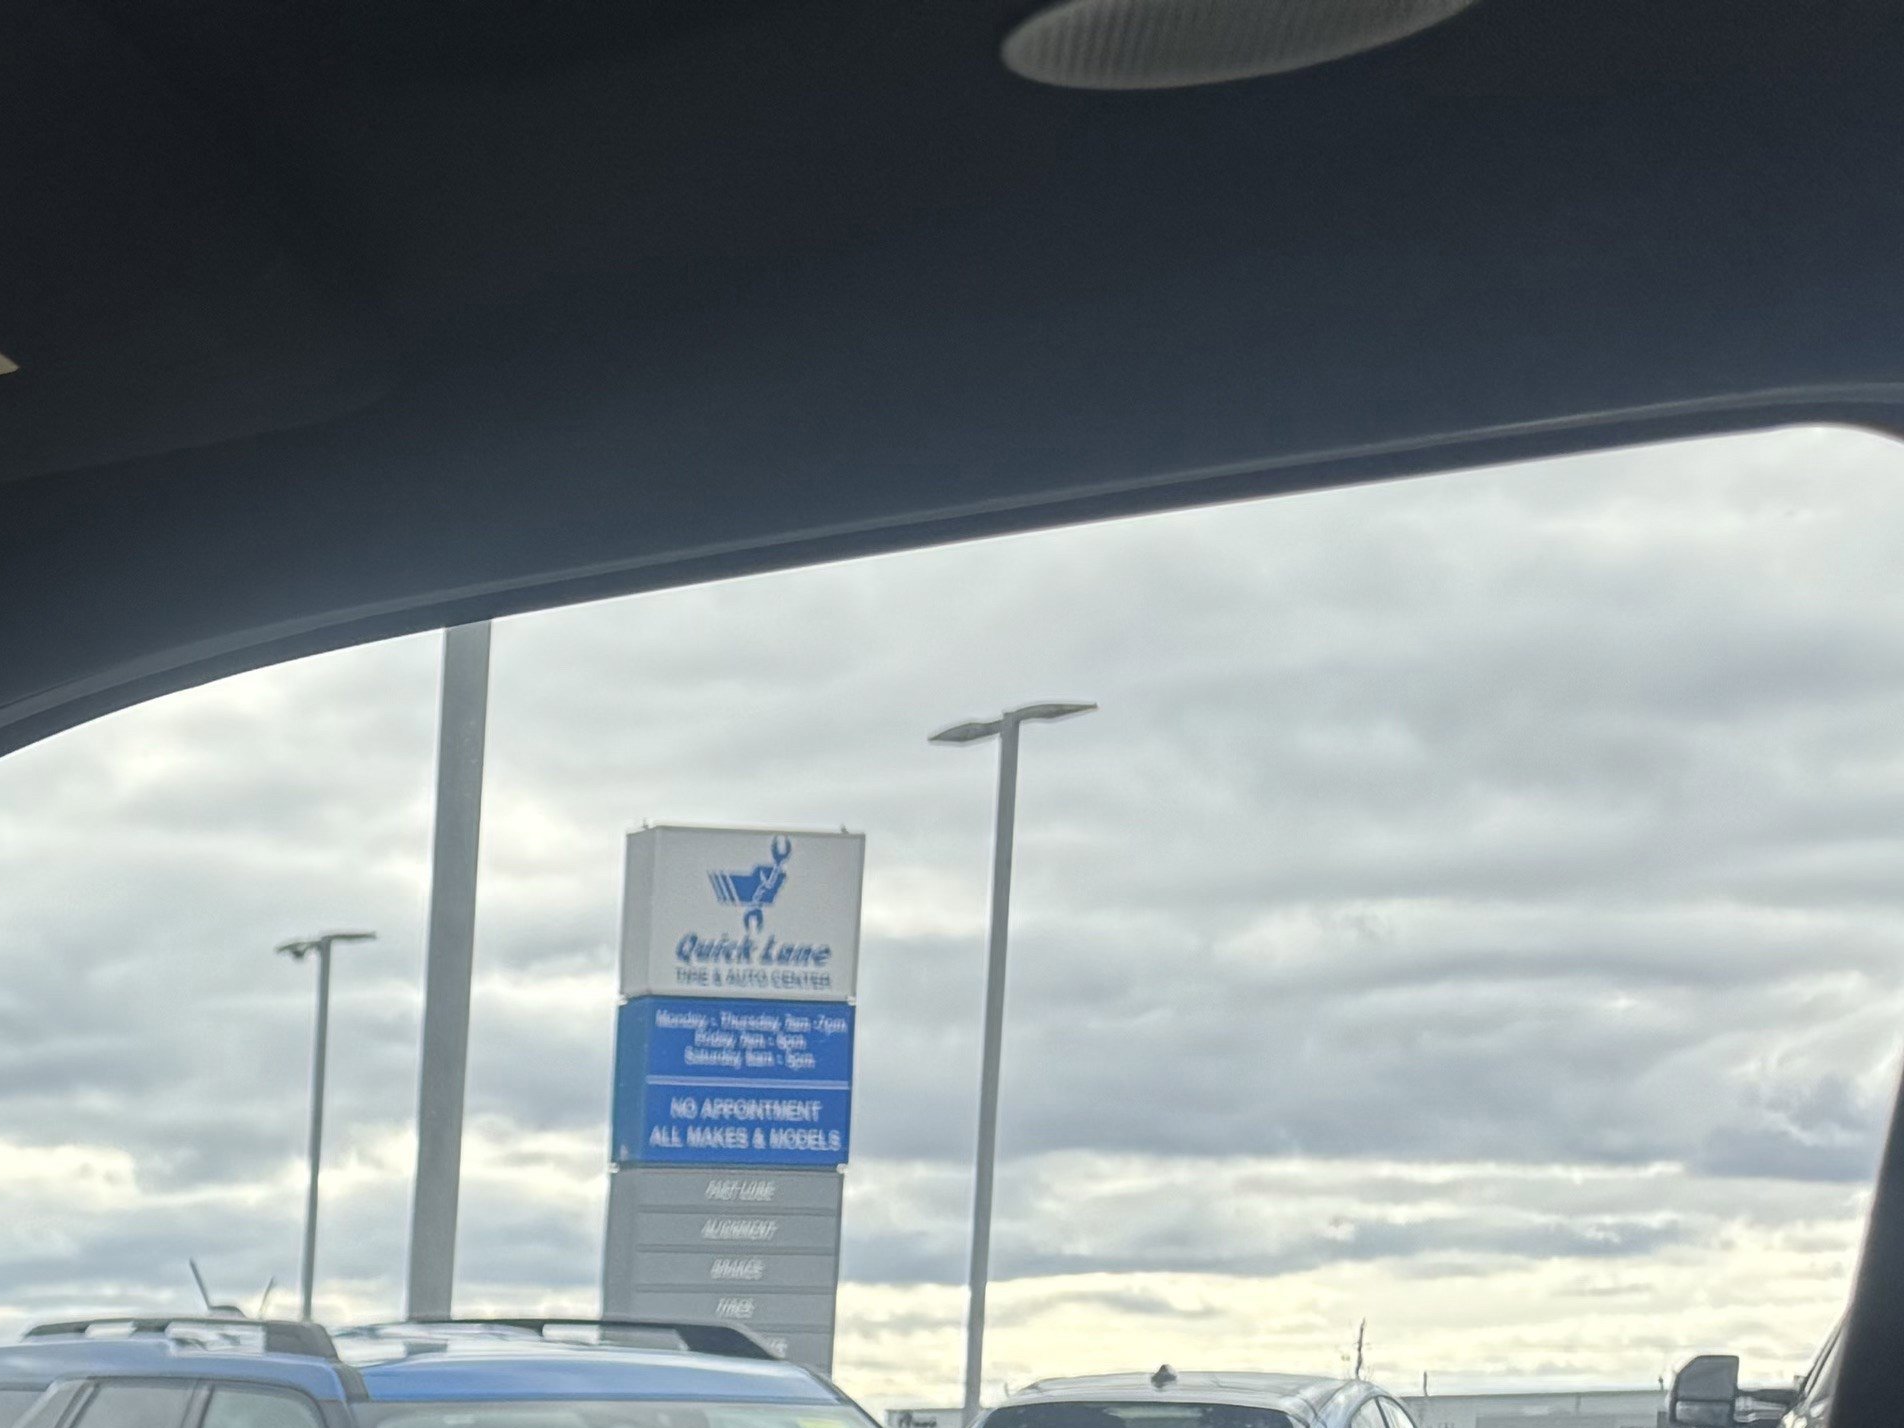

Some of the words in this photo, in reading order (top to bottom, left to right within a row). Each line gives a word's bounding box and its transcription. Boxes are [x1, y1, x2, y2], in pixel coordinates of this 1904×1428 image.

[675, 932, 755, 965] Quick
[760, 935, 832, 966] Lane
[676, 967, 708, 986] TIRE
[725, 968, 768, 988] AUTO
[770, 969, 830, 989] CENTER
[670, 1097, 698, 1120] NO
[701, 1098, 823, 1122] APPOINTMENT
[649, 1125, 683, 1148] ALL
[687, 1126, 748, 1149] MAKES
[752, 1127, 766, 1149] &
[769, 1128, 842, 1151] MODELS
